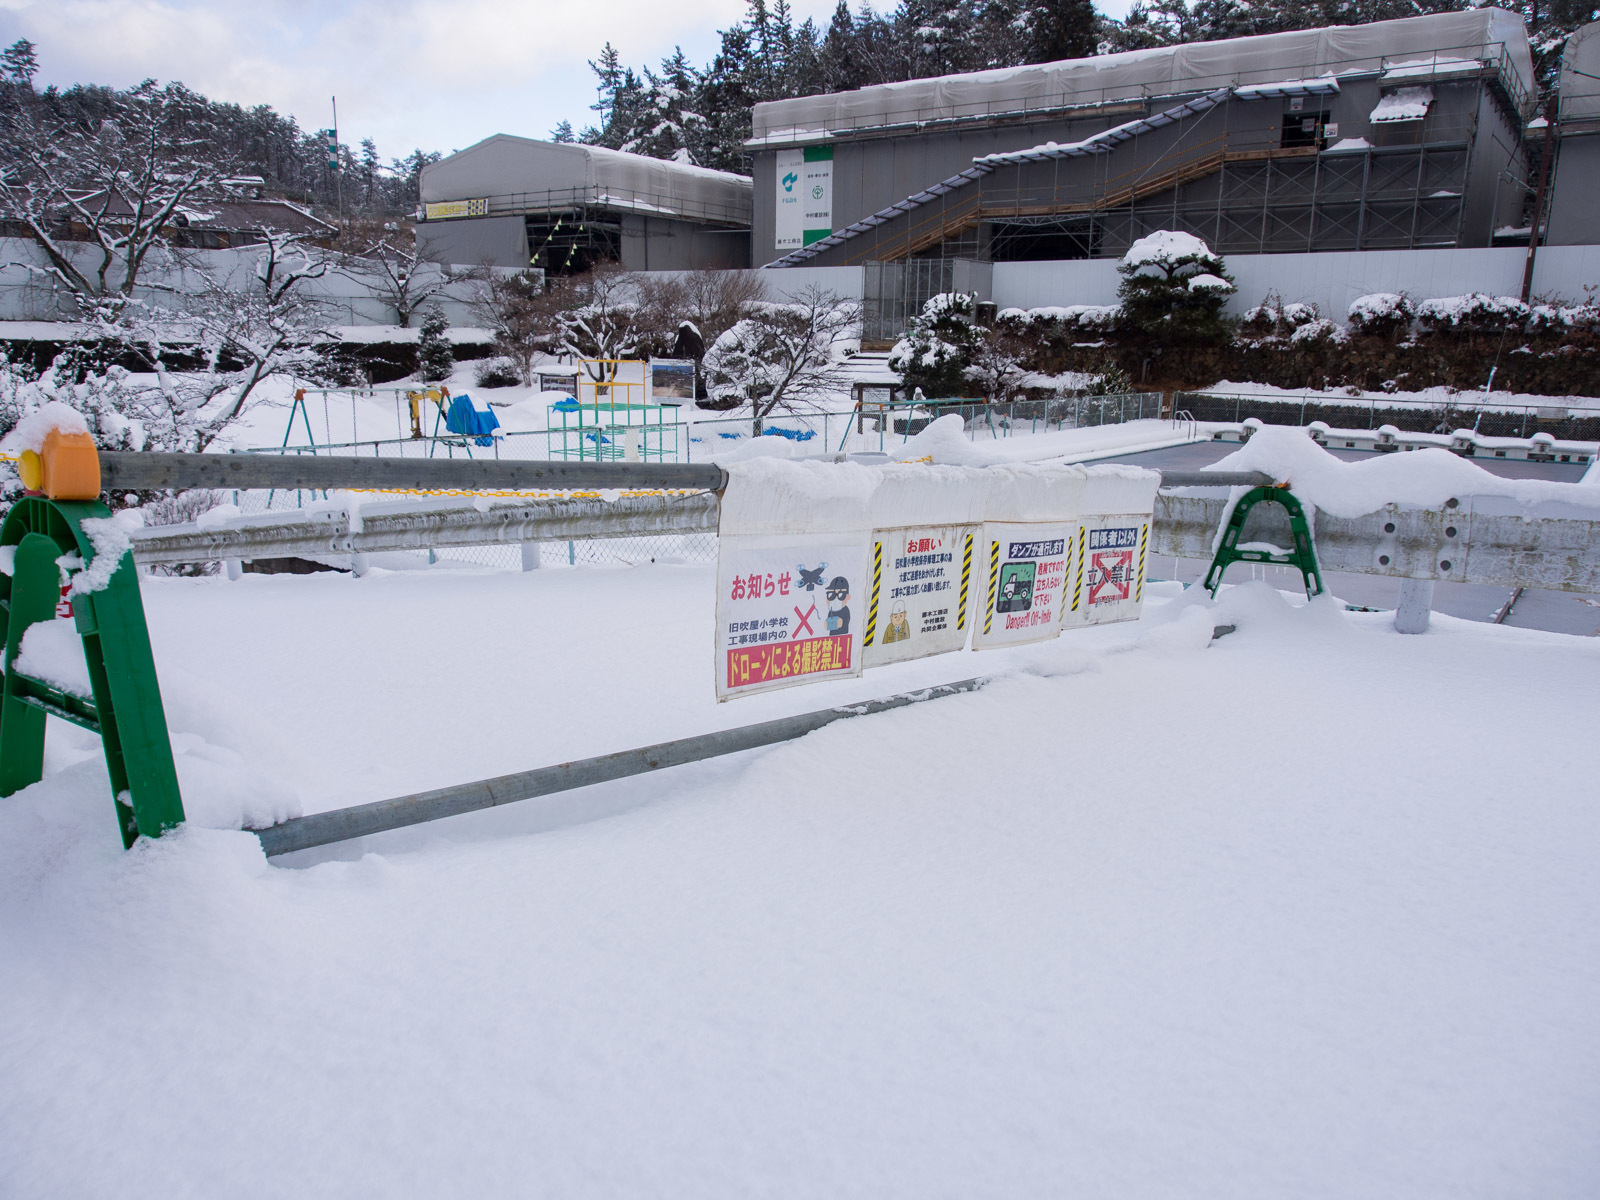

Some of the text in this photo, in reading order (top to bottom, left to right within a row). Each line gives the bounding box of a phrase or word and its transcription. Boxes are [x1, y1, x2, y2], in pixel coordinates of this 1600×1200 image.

[907, 538, 942, 553] お願い
[1090, 529, 1136, 548] 関係者以外
[1011, 542, 1064, 557] ダンプが通行します
[1037, 560, 1065, 576] 危険ですので
[1086, 564, 1135, 587] 立入禁止
[731, 571, 791, 601] お知らせ
[1035, 576, 1062, 591] 立ち入らない
[728, 617, 789, 633] 旧吹屋小学校
[728, 630, 788, 646] 工事現場内の
[731, 637, 851, 686] ドローンによる撮影禁止！
